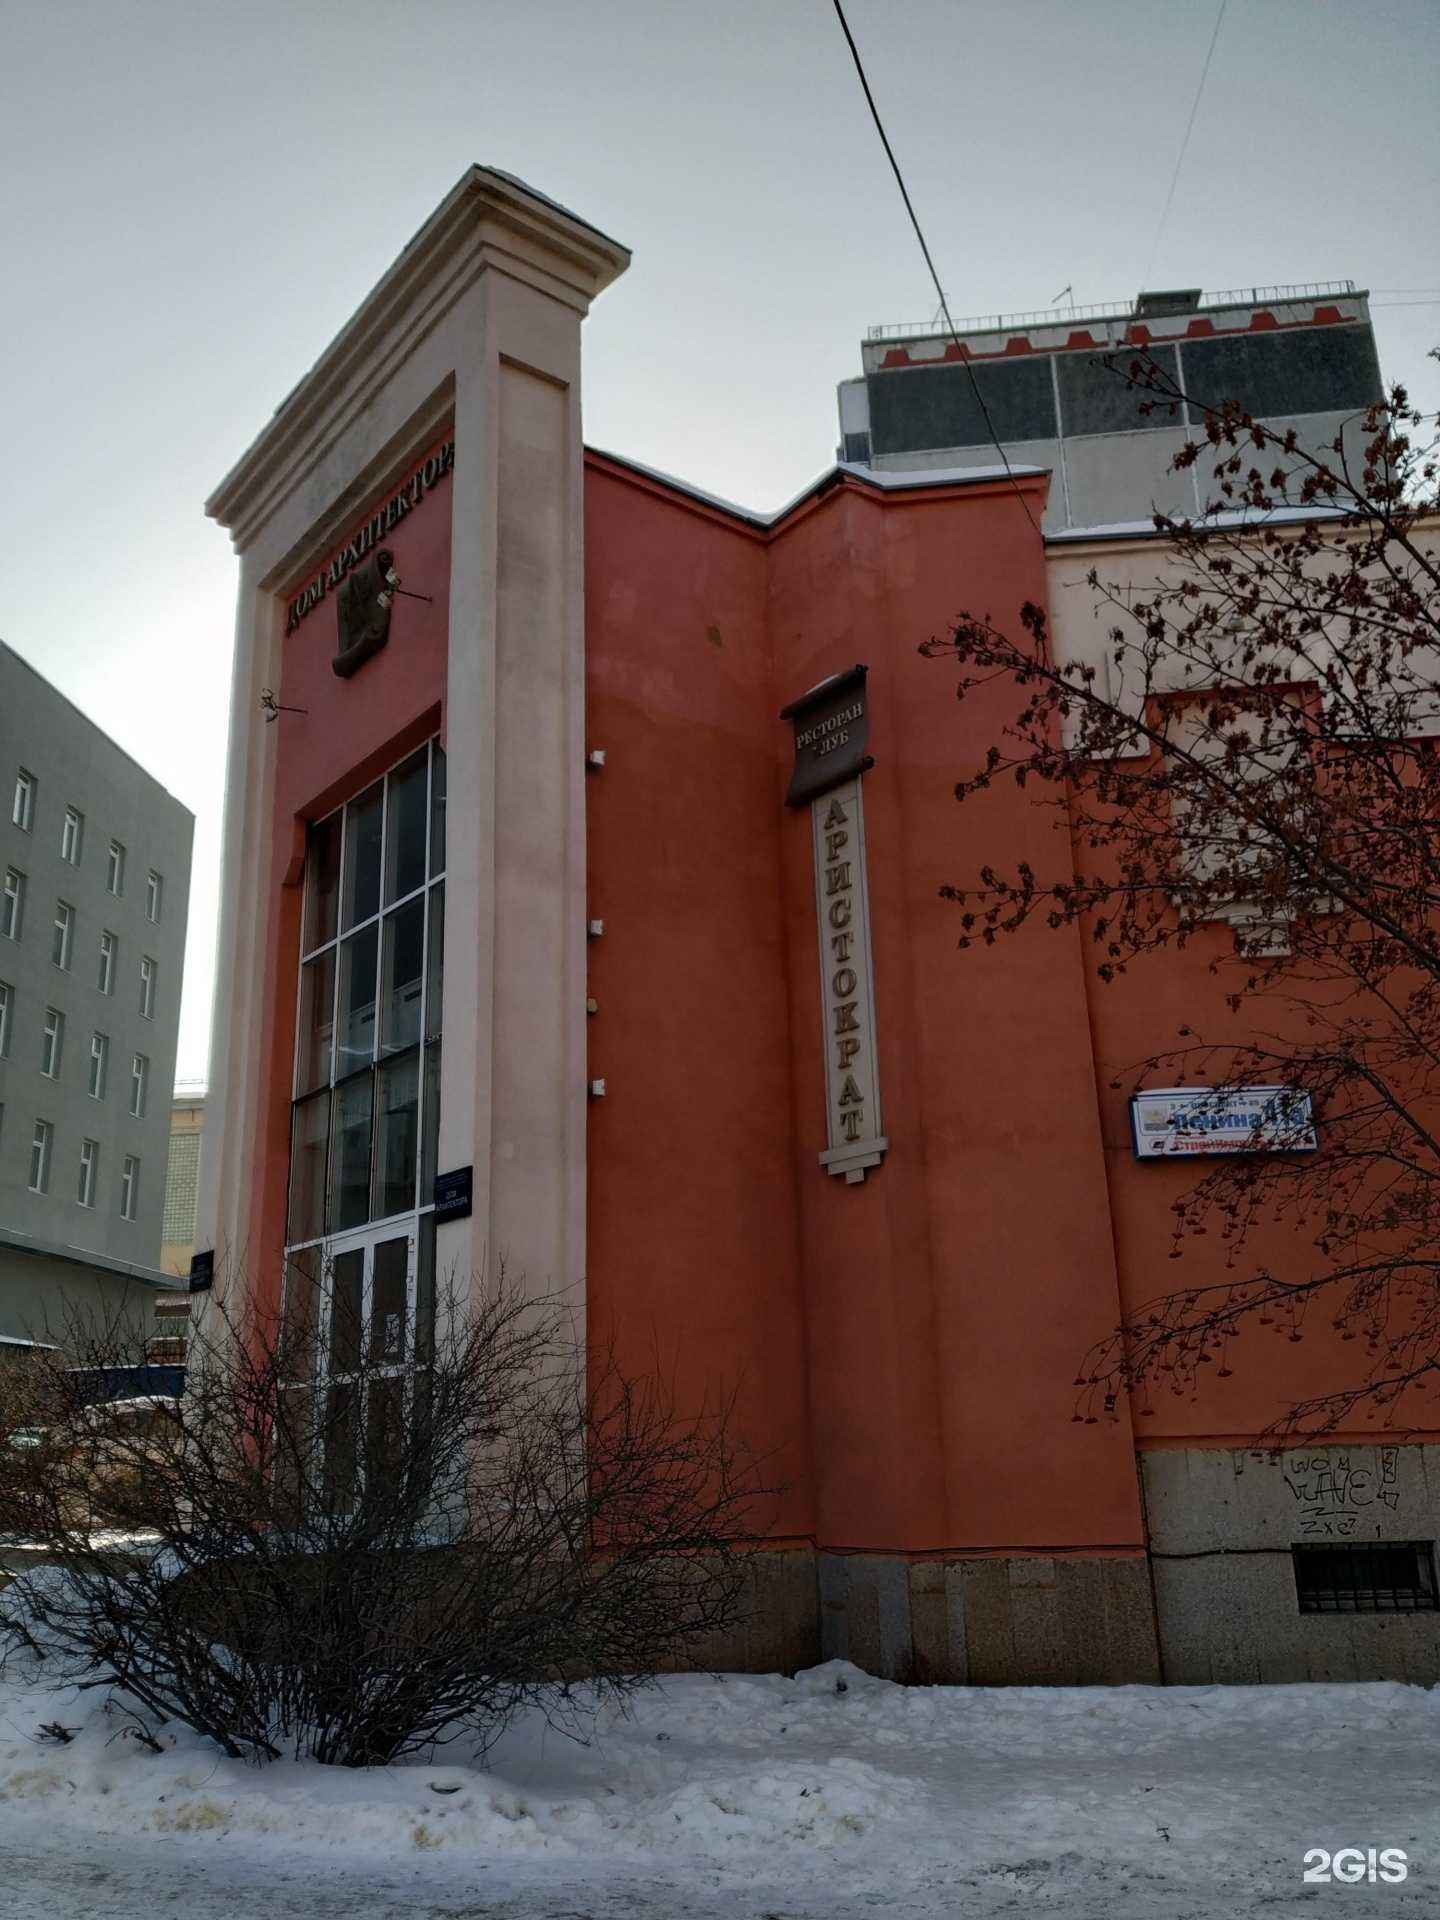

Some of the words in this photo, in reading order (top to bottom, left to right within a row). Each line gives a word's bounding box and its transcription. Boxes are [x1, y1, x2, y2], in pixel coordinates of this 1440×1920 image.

[796, 703, 863, 750] РЕСТОРАН
[812, 729, 849, 755] ЛУБ
[823, 799, 864, 1142] АРИСТОКРАТ
